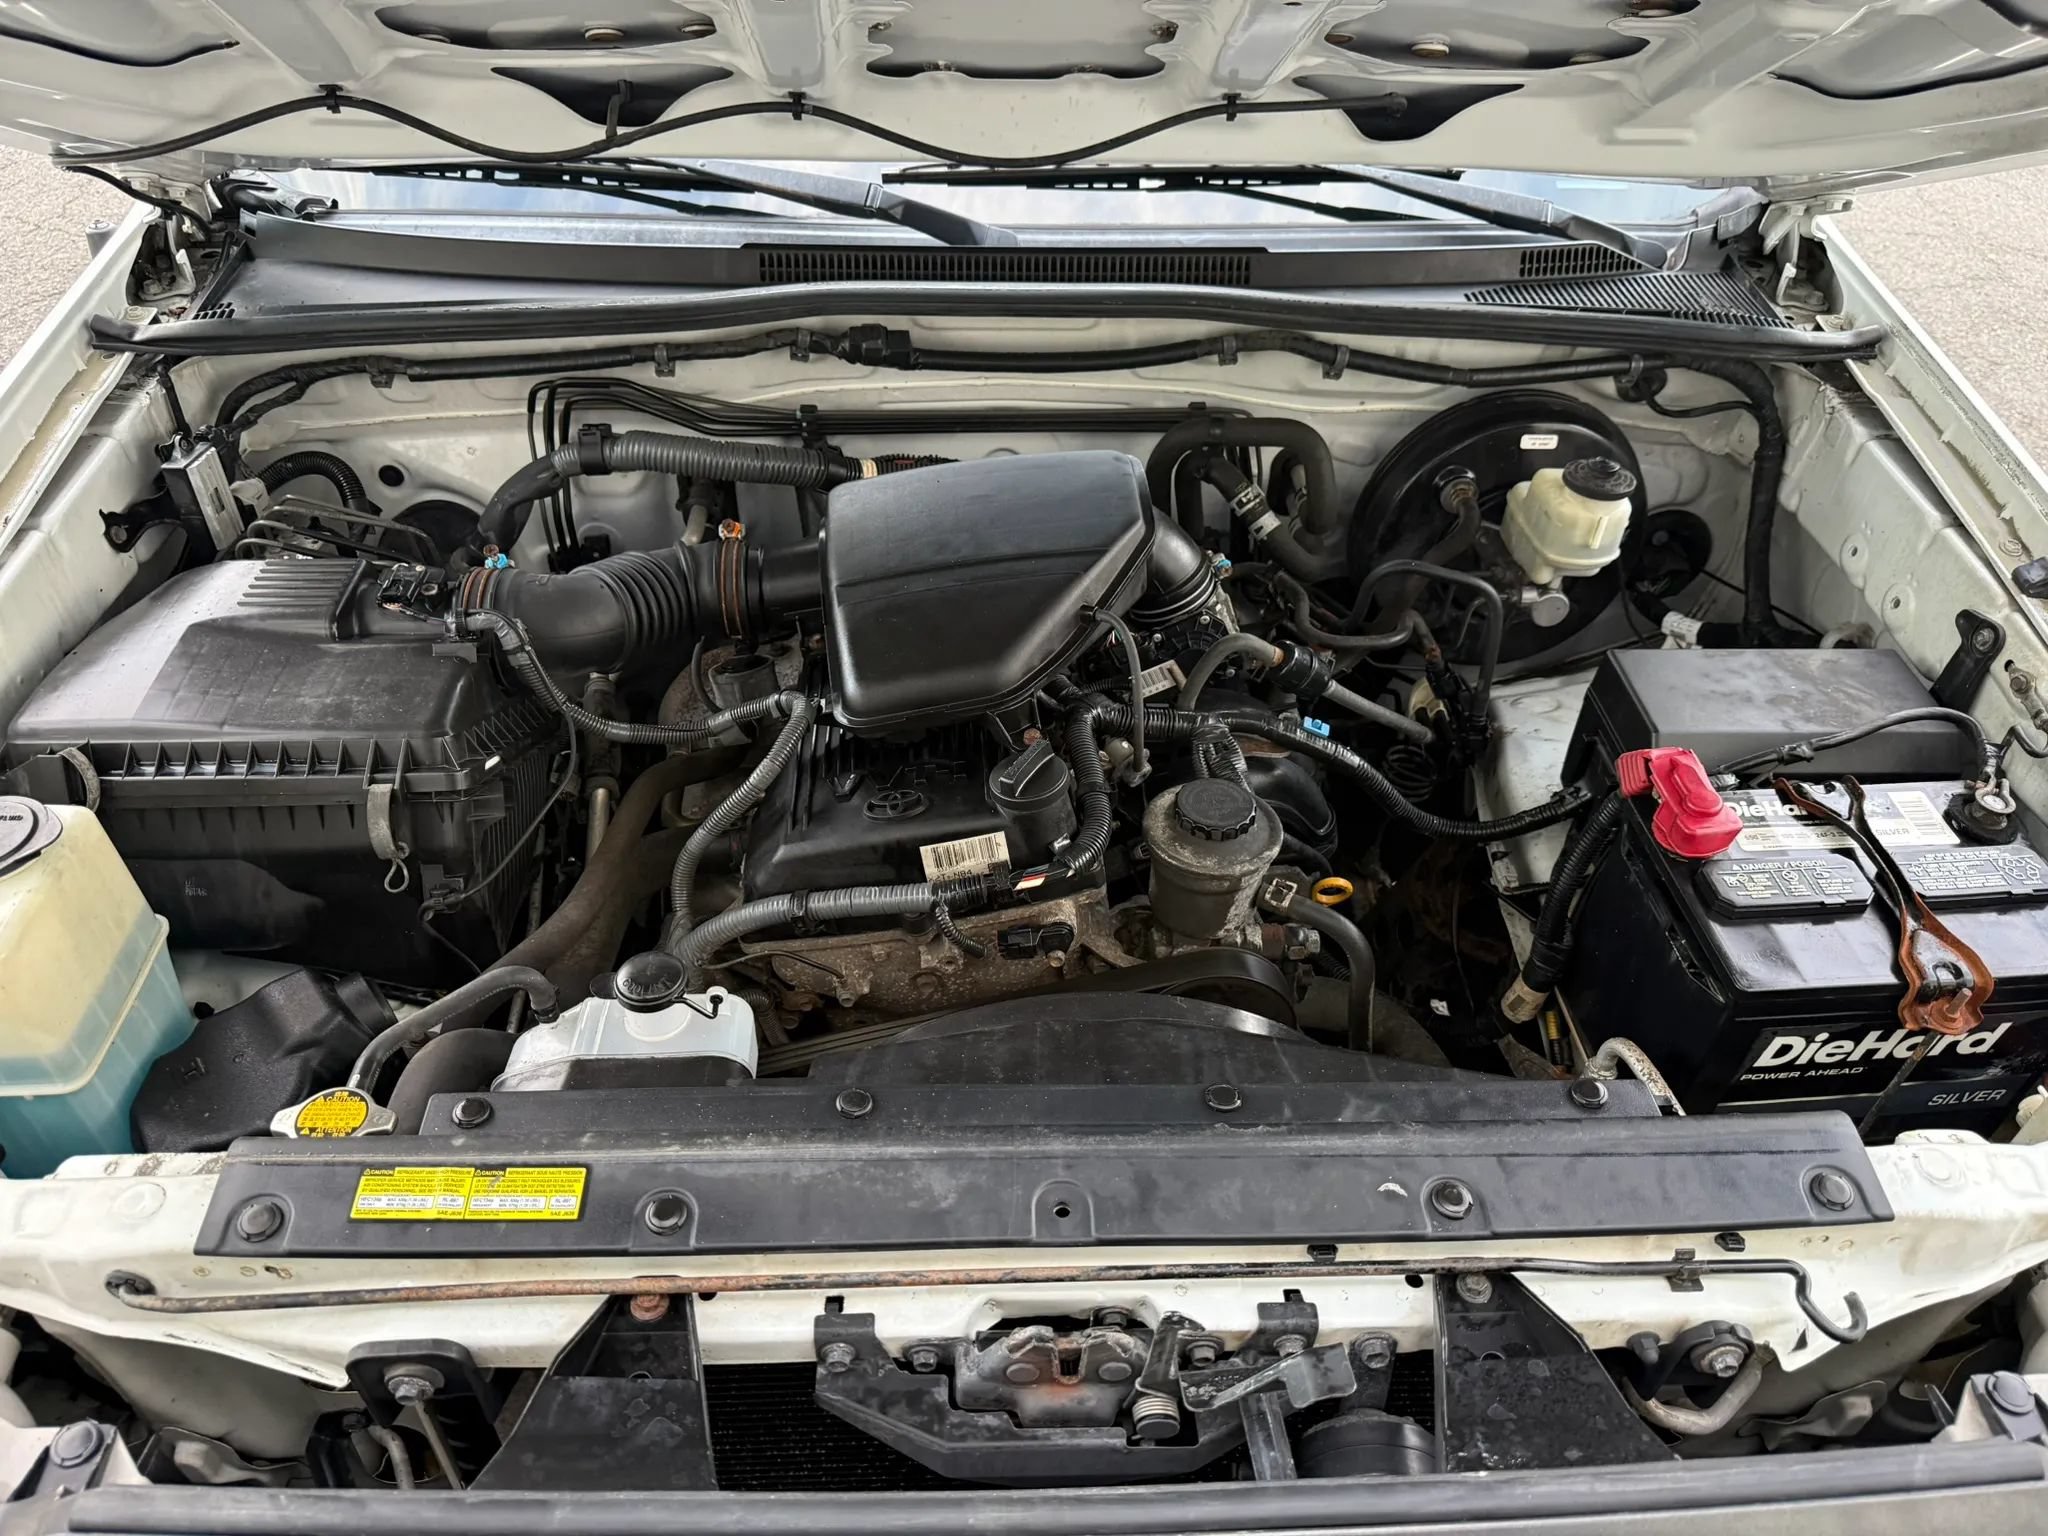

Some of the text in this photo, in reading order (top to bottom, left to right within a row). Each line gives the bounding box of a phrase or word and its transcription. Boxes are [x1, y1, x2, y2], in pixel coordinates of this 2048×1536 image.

[1742, 862, 1783, 870] DANGER
[1790, 859, 1827, 868] POISON
[1752, 1022, 2013, 1068] DieHard
[1740, 1066, 1864, 1081] POWER AHEAD
[1927, 1088, 2007, 1106] SILVER
